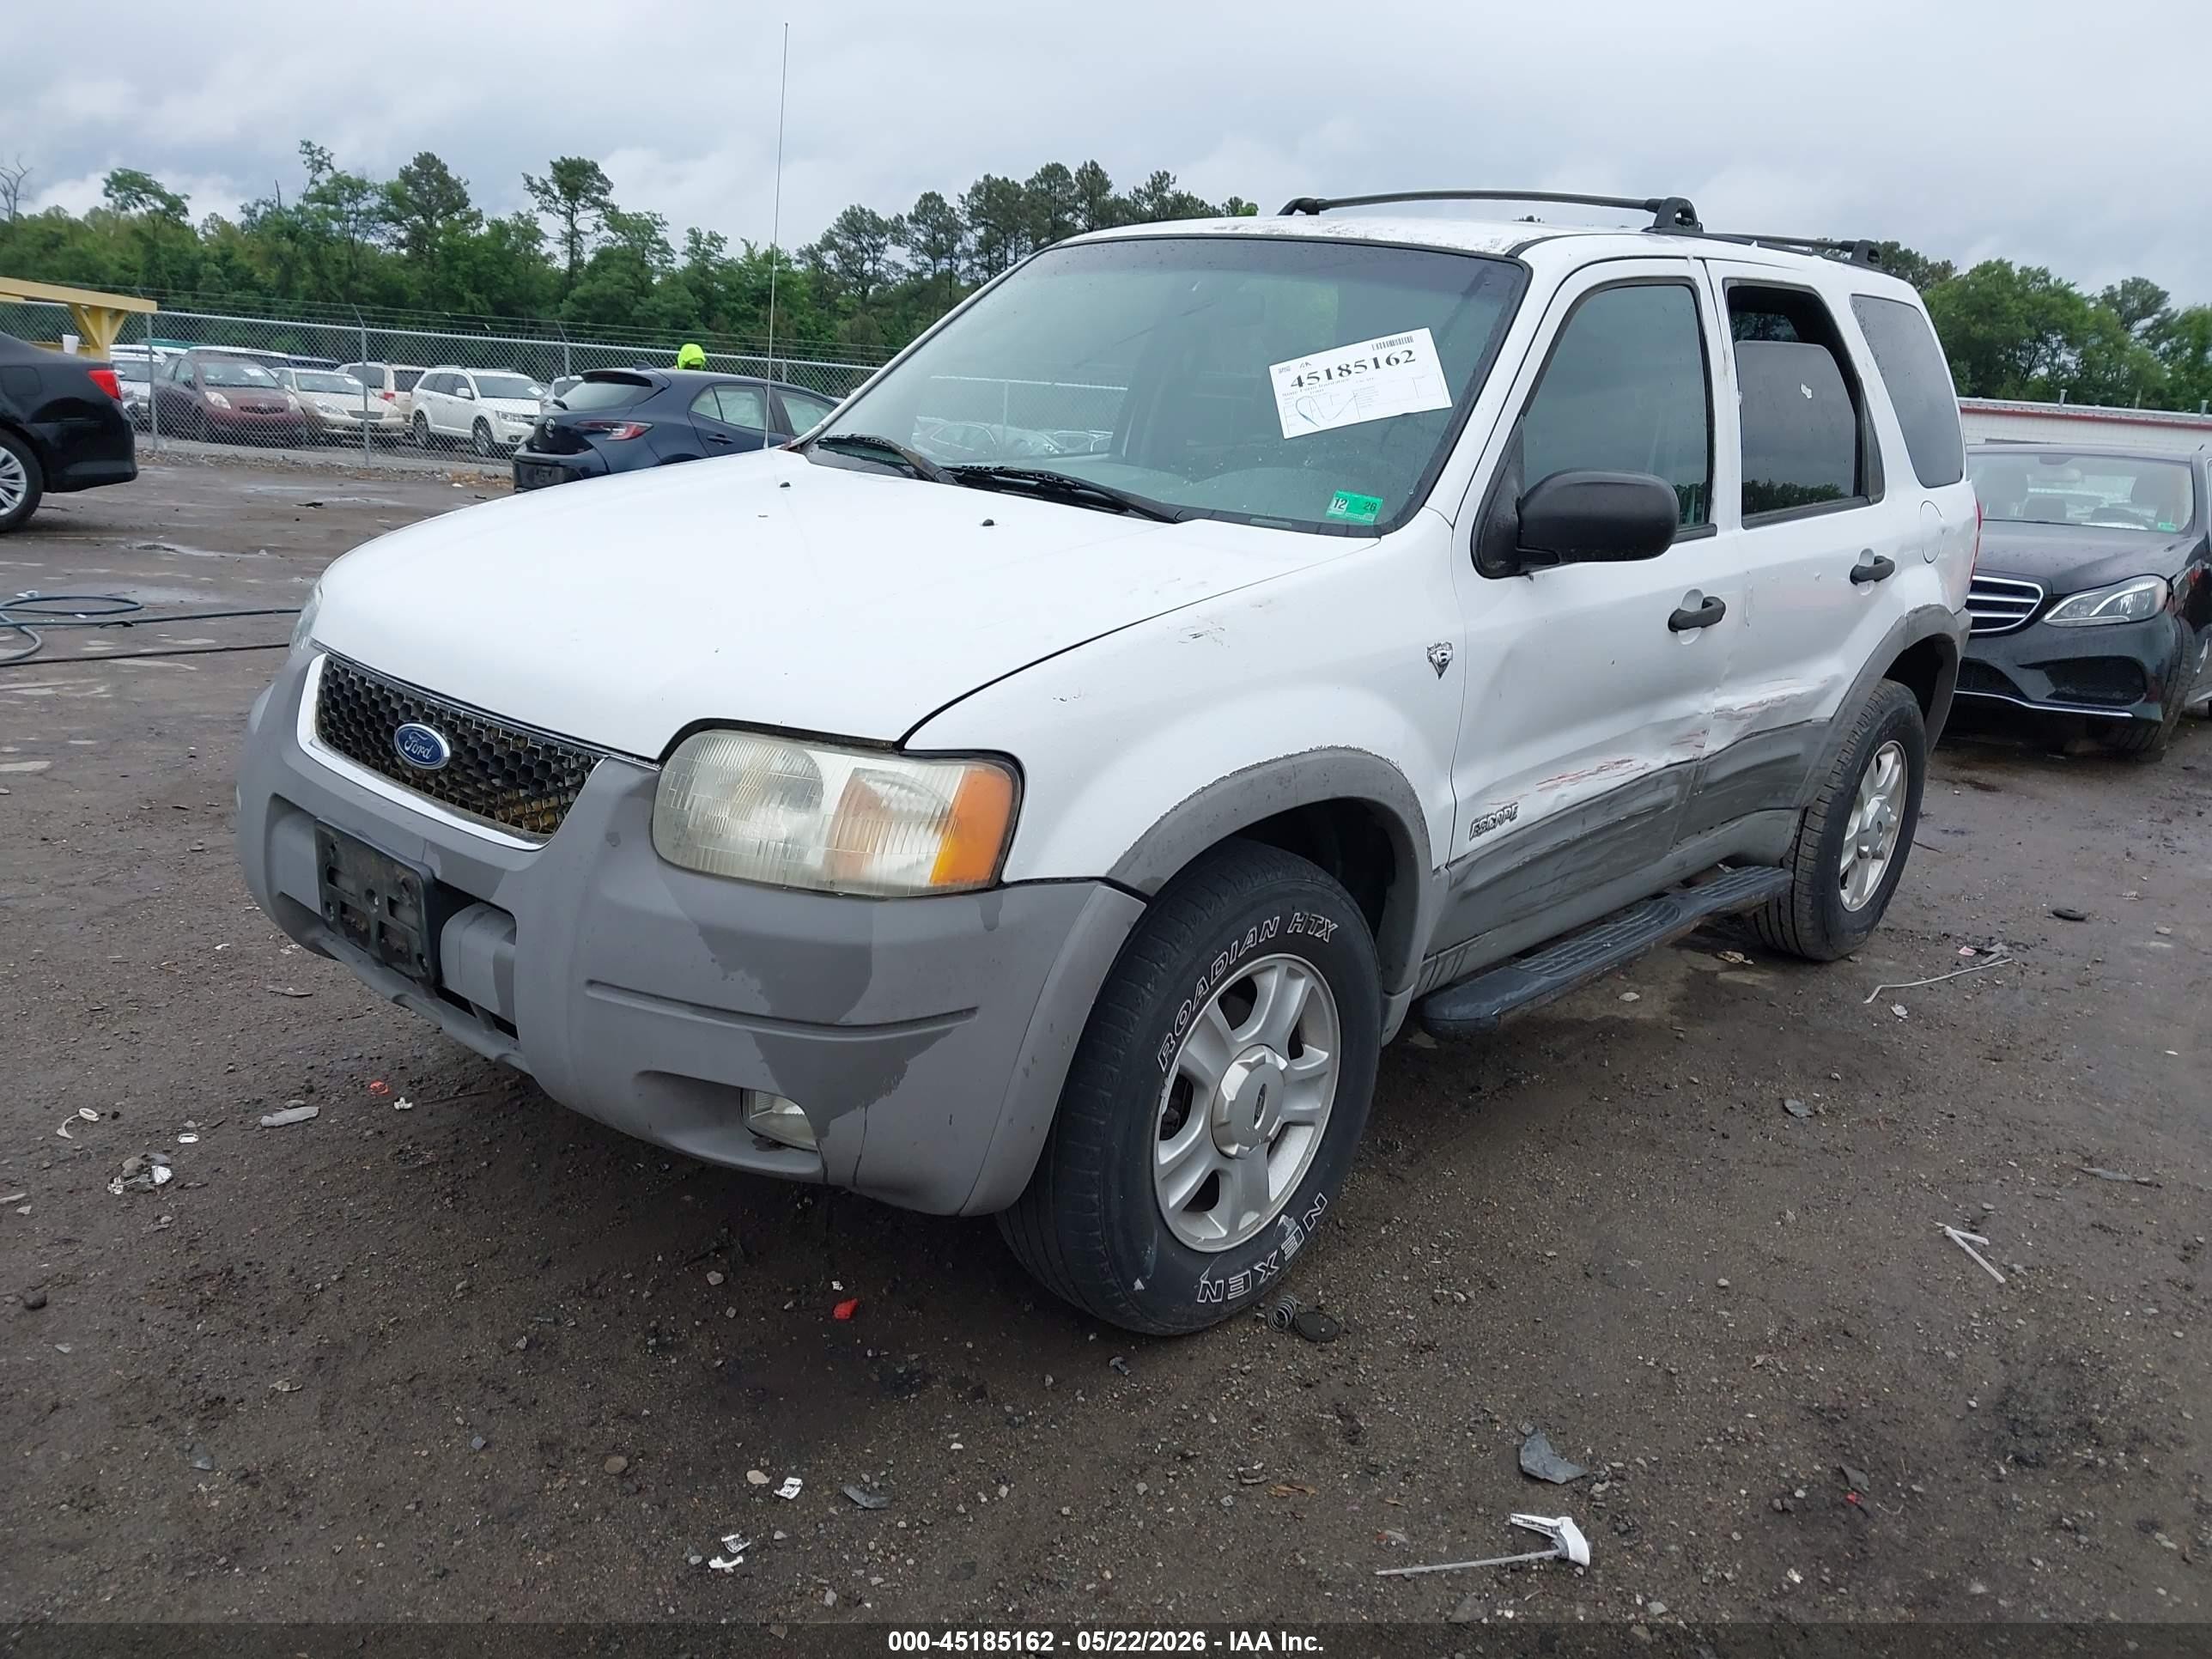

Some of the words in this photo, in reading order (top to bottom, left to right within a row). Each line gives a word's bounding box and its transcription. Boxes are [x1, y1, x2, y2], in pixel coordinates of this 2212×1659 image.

[1291, 349, 1416, 388] 45185162
[1334, 498, 1348, 510] 12
[404, 731, 434, 760] Ford
[1469, 802, 1519, 842] ESCAPE
[1157, 915, 1281, 1073] ROADIAN
[1286, 911, 1339, 944] HTX
[1197, 1193, 1328, 1304] NEXEN
